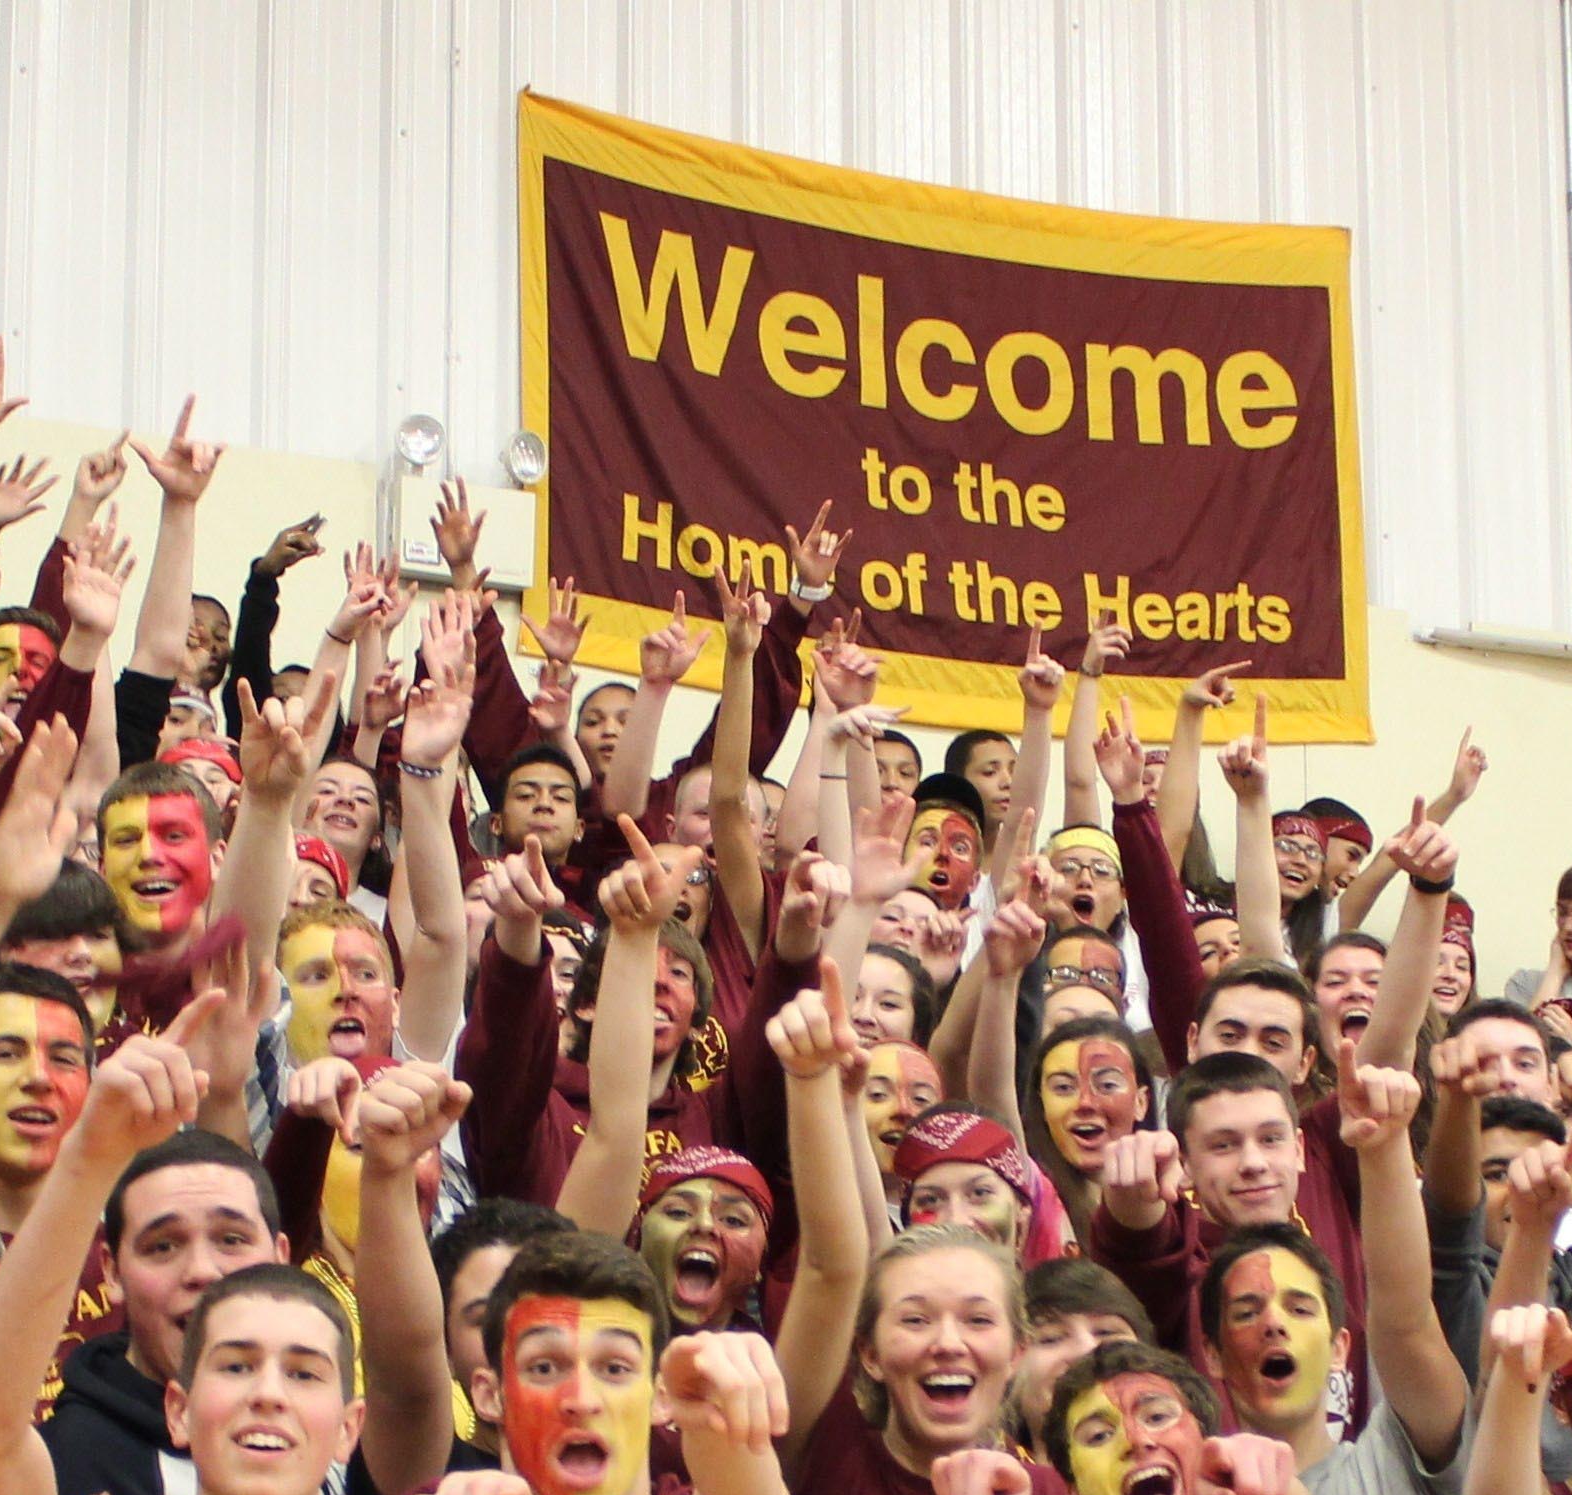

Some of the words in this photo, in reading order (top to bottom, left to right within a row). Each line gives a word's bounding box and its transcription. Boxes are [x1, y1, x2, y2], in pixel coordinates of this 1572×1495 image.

[598, 209, 1299, 450] Welcome
[860, 447, 933, 517] to
[954, 462, 1066, 532] the
[621, 493, 834, 597] Hom
[860, 553, 930, 619] of
[948, 560, 1063, 632] the
[1083, 573, 1292, 645] Hearts
